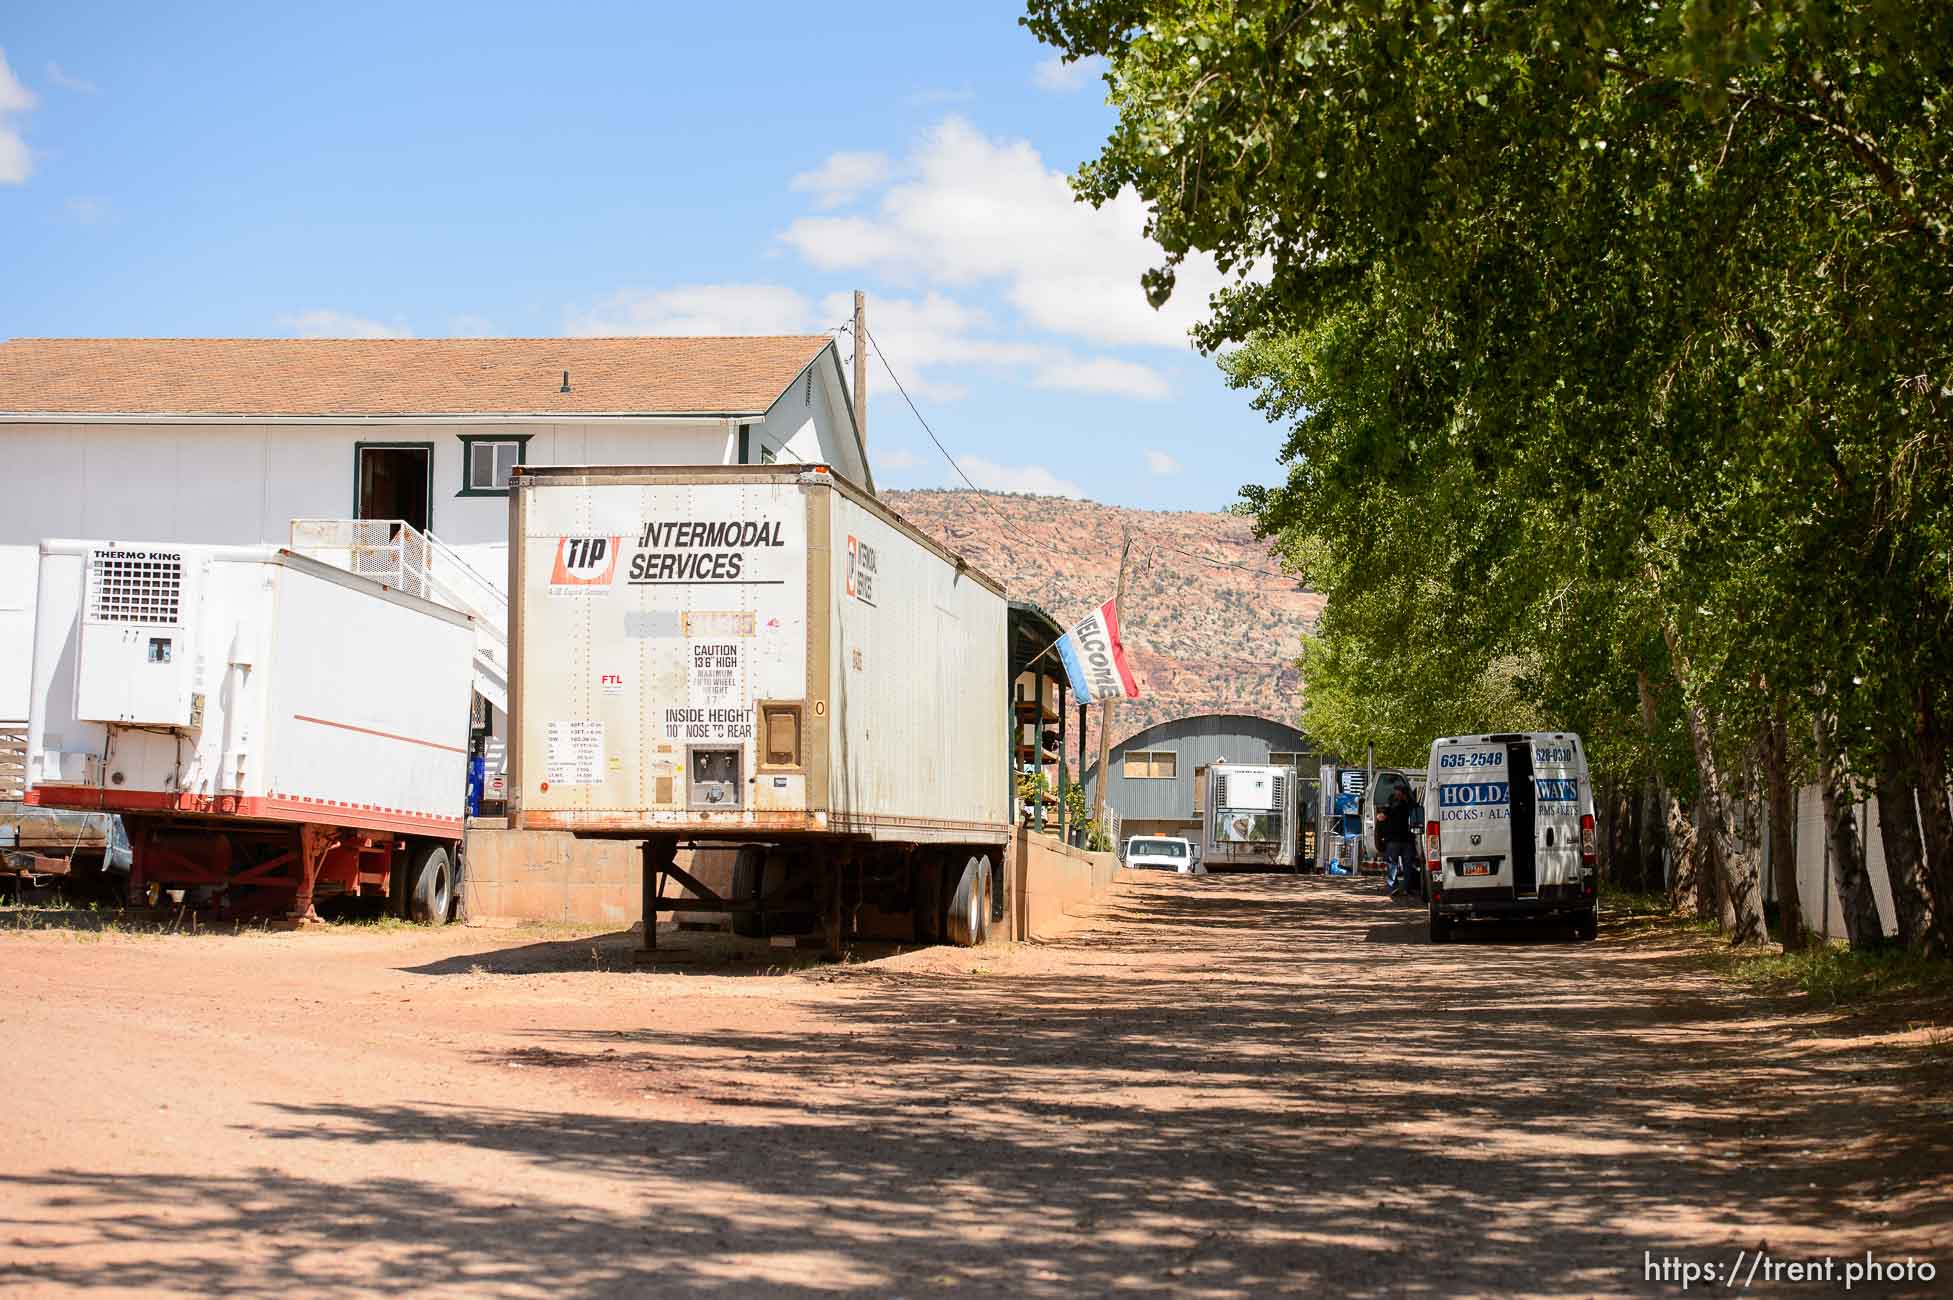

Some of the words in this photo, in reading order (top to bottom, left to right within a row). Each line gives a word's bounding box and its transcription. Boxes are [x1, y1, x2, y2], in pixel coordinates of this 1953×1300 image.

[94, 550, 146, 560] THERMO
[149, 552, 182, 561] KING
[567, 538, 607, 569] TIP
[629, 553, 743, 580] SERVICES
[694, 645, 737, 656] CAUTION
[716, 657, 737, 668] HIGH
[602, 675, 623, 685] FTL
[666, 709, 704, 722] INSIDE
[709, 709, 752, 722] HEIGHT
[686, 724, 710, 738] NOSE
[727, 724, 752, 738] REAR
[1440, 752, 1503, 768] 635-2548
[1441, 809, 1478, 821] LOCKS
